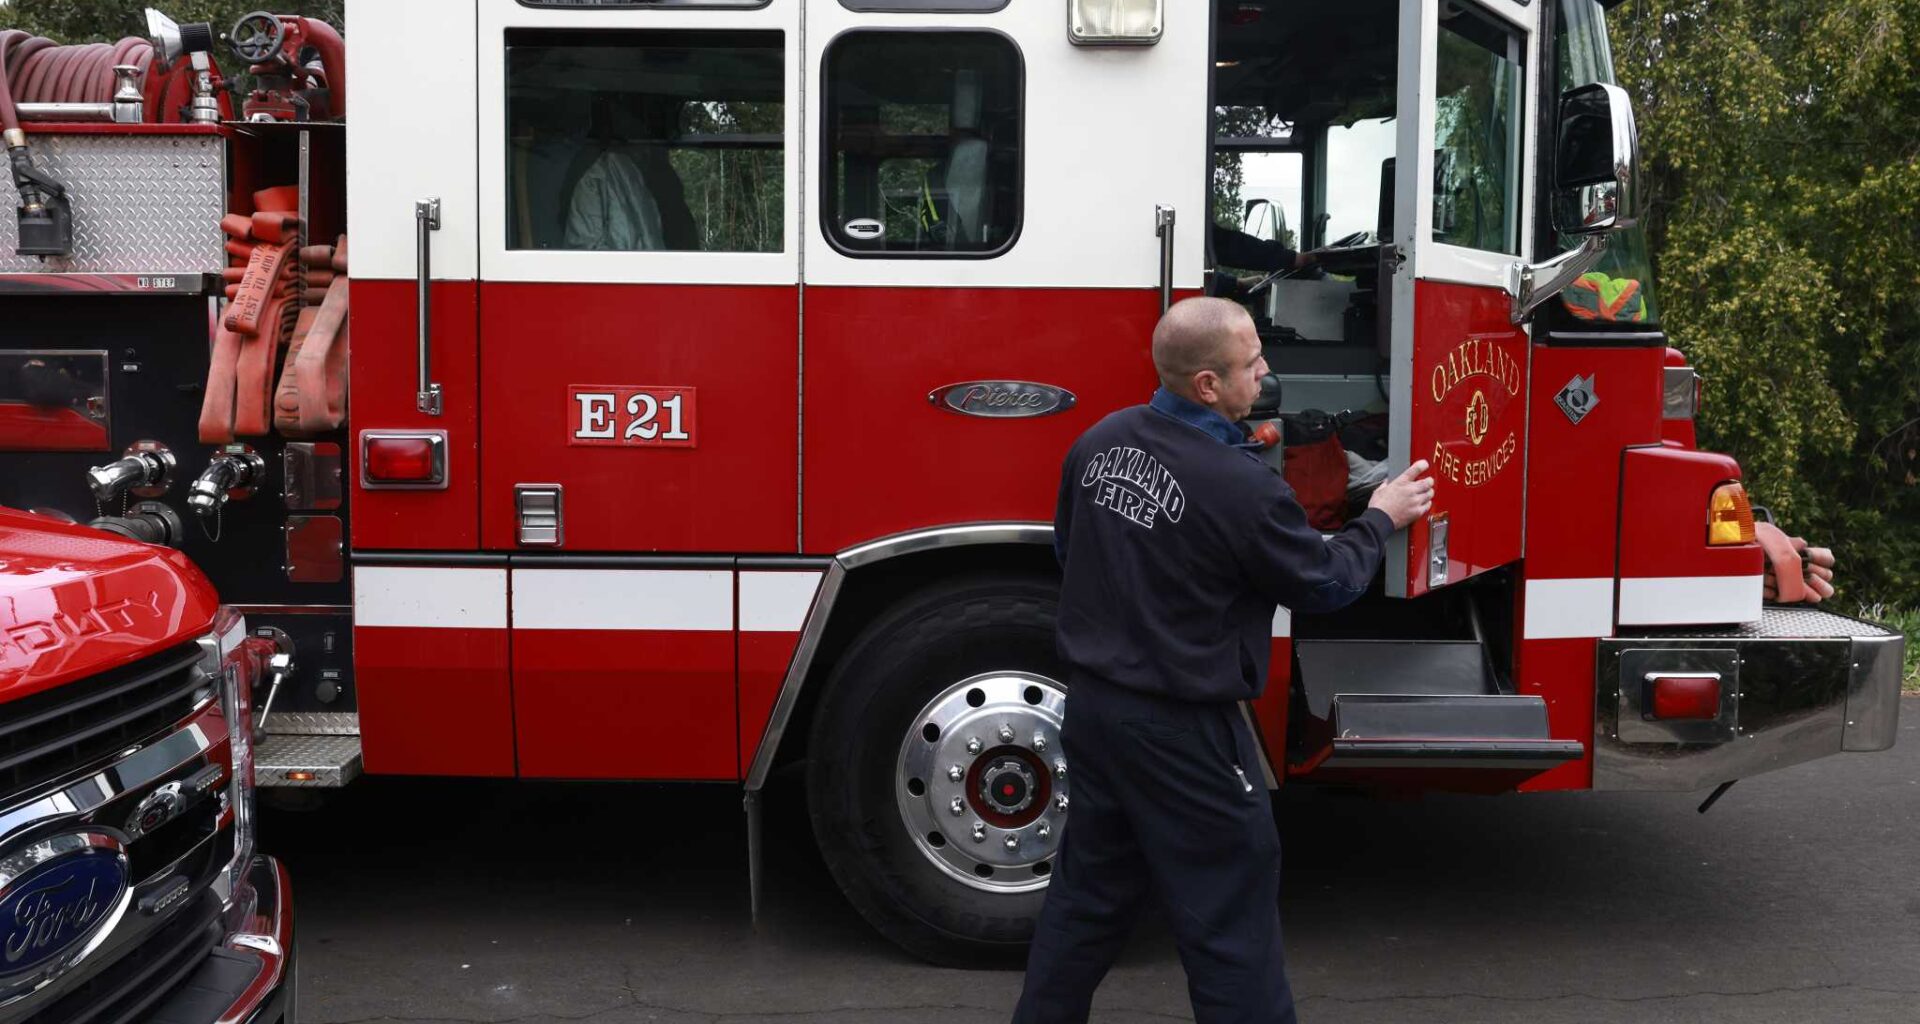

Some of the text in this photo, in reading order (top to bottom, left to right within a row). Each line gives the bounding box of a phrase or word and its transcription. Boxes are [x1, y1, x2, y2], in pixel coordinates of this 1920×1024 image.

[137, 277, 176, 288] NO STEP
[240, 294, 260, 321] TEST
[252, 278, 267, 290] TO
[960, 384, 1042, 410] Pierce
[1433, 339, 1520, 402] OAKLAND
[1081, 446, 1186, 524] OAKLAND
[1433, 431, 1516, 486] FIRE SERVICES
[1094, 478, 1159, 529] FIRE
[5, 590, 163, 656] DUTY
[5, 874, 98, 963] Ford
